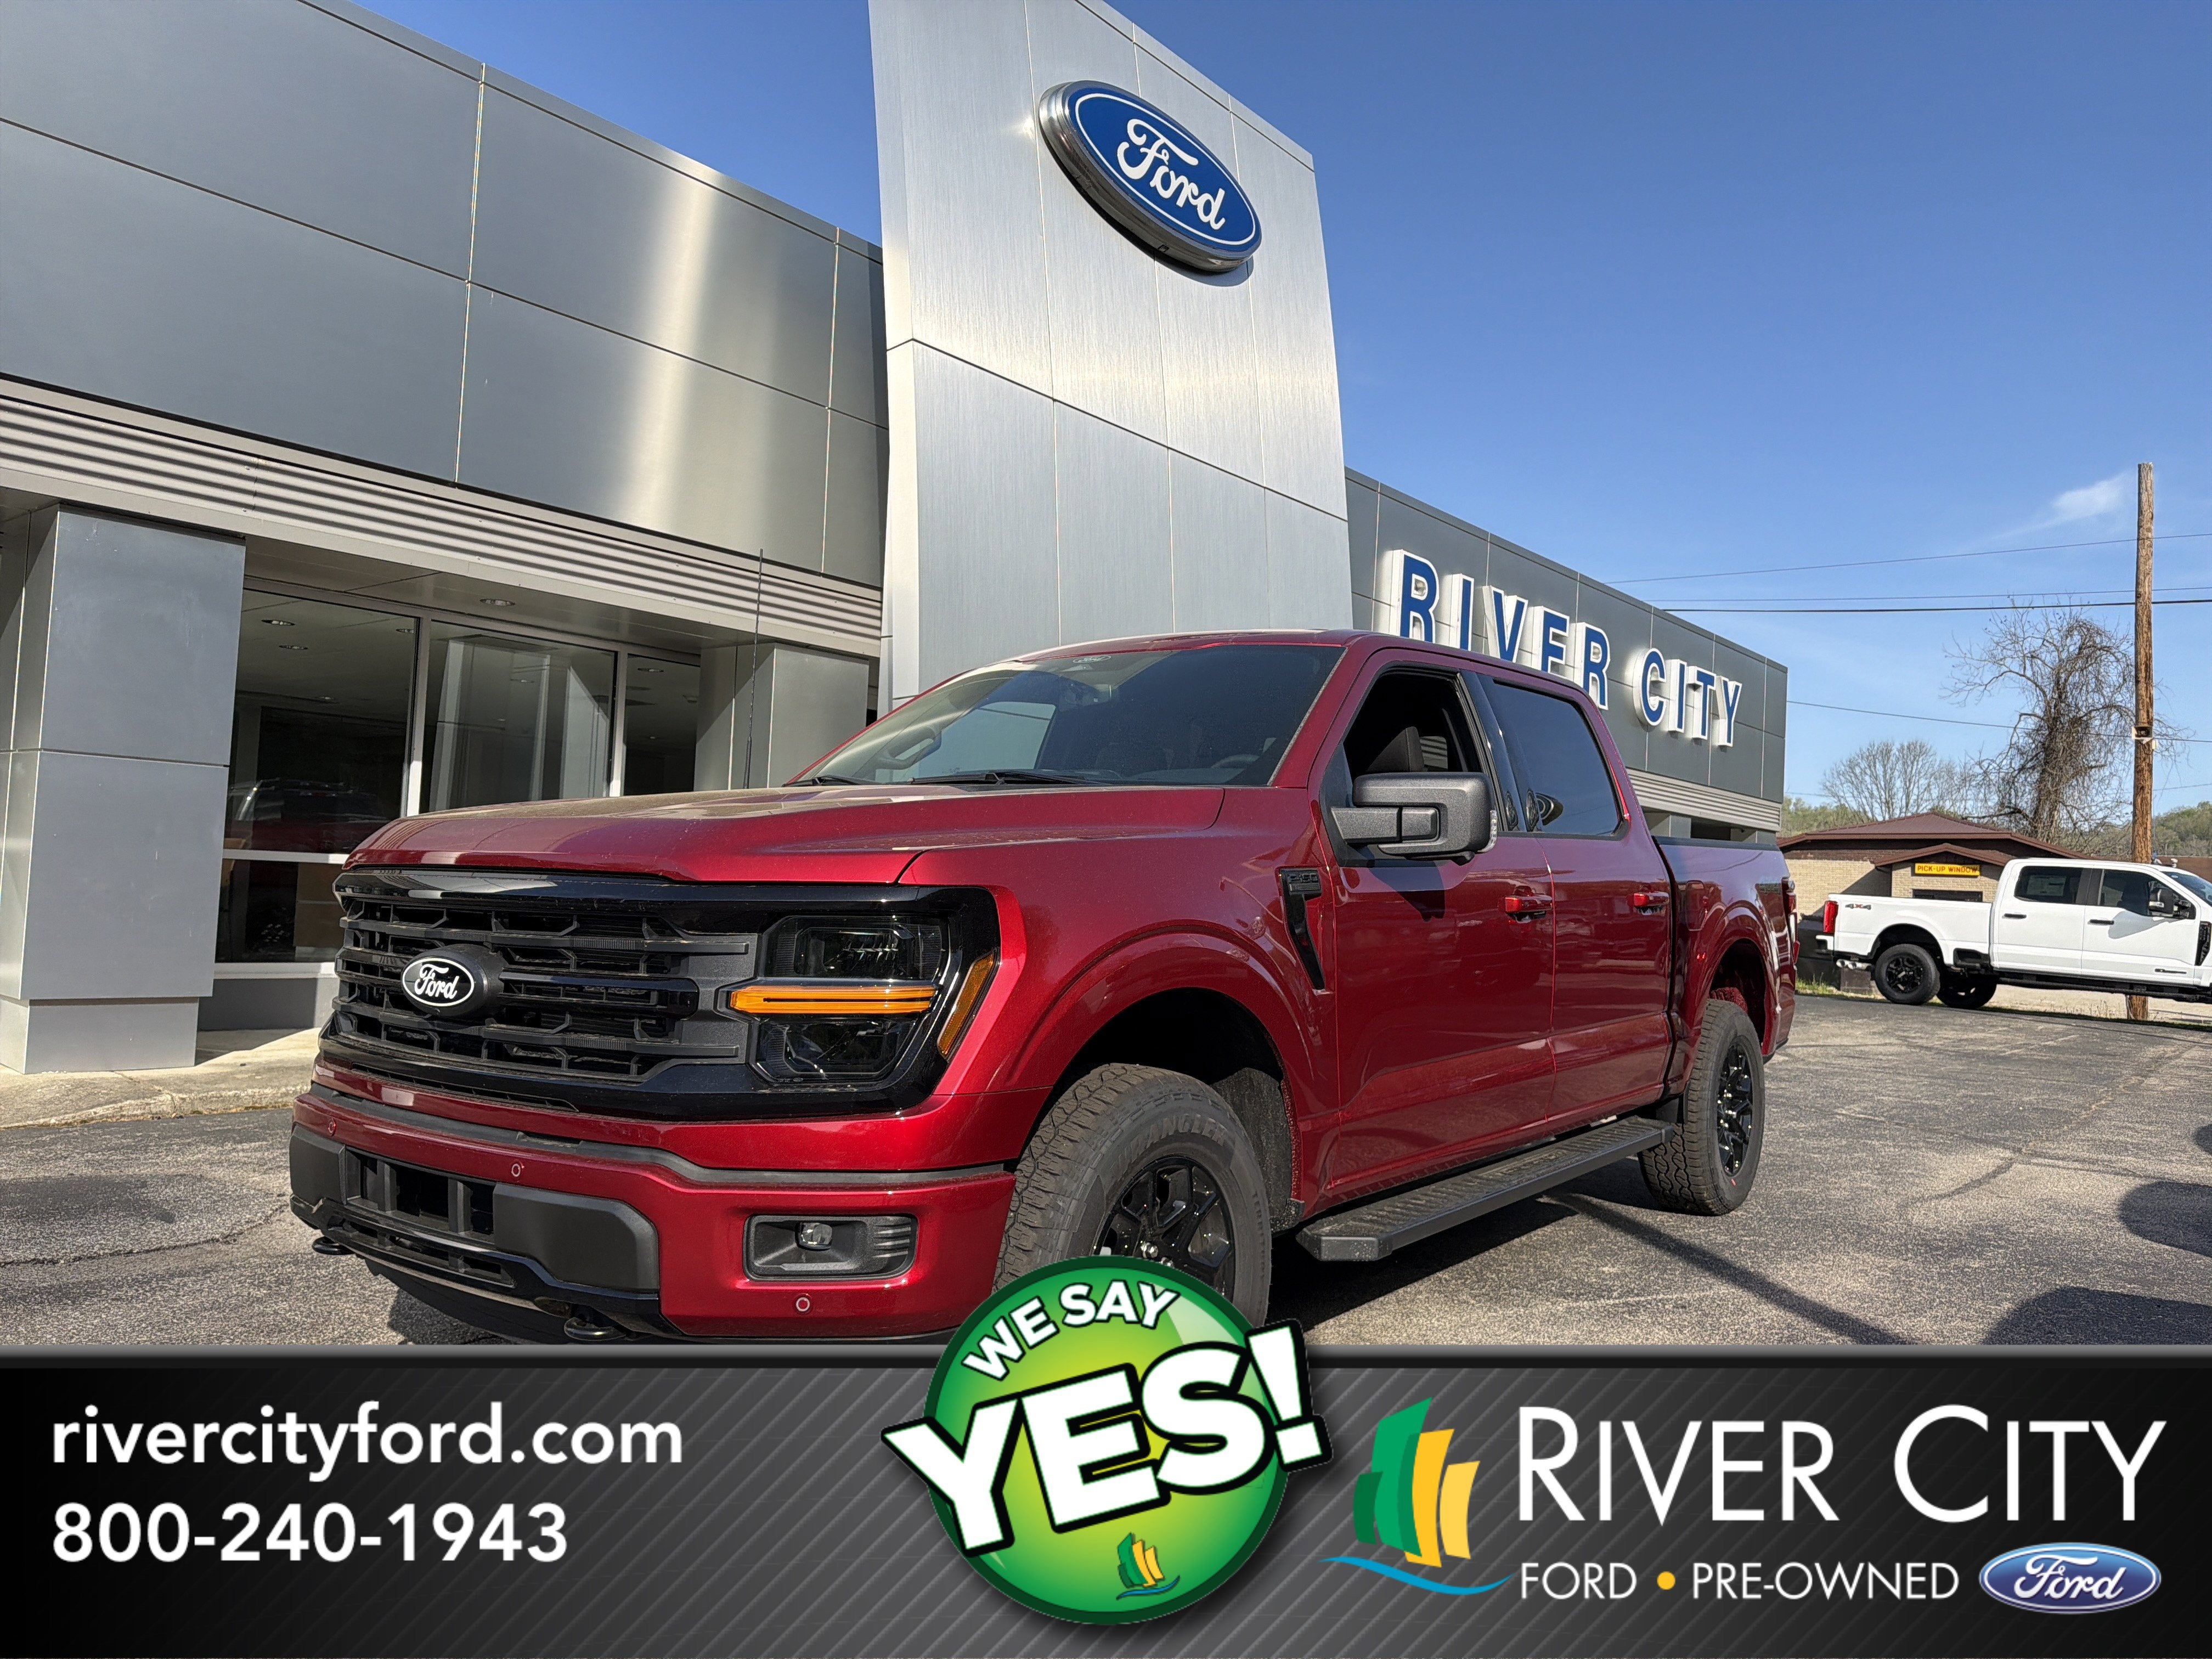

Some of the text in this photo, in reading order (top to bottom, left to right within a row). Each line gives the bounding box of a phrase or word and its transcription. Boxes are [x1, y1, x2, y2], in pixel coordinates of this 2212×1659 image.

[1117, 118, 1226, 230] Ford
[1392, 549, 1743, 748] RIVER CITY
[1948, 865, 1978, 873] WINDOW
[414, 963, 460, 1000] Ford
